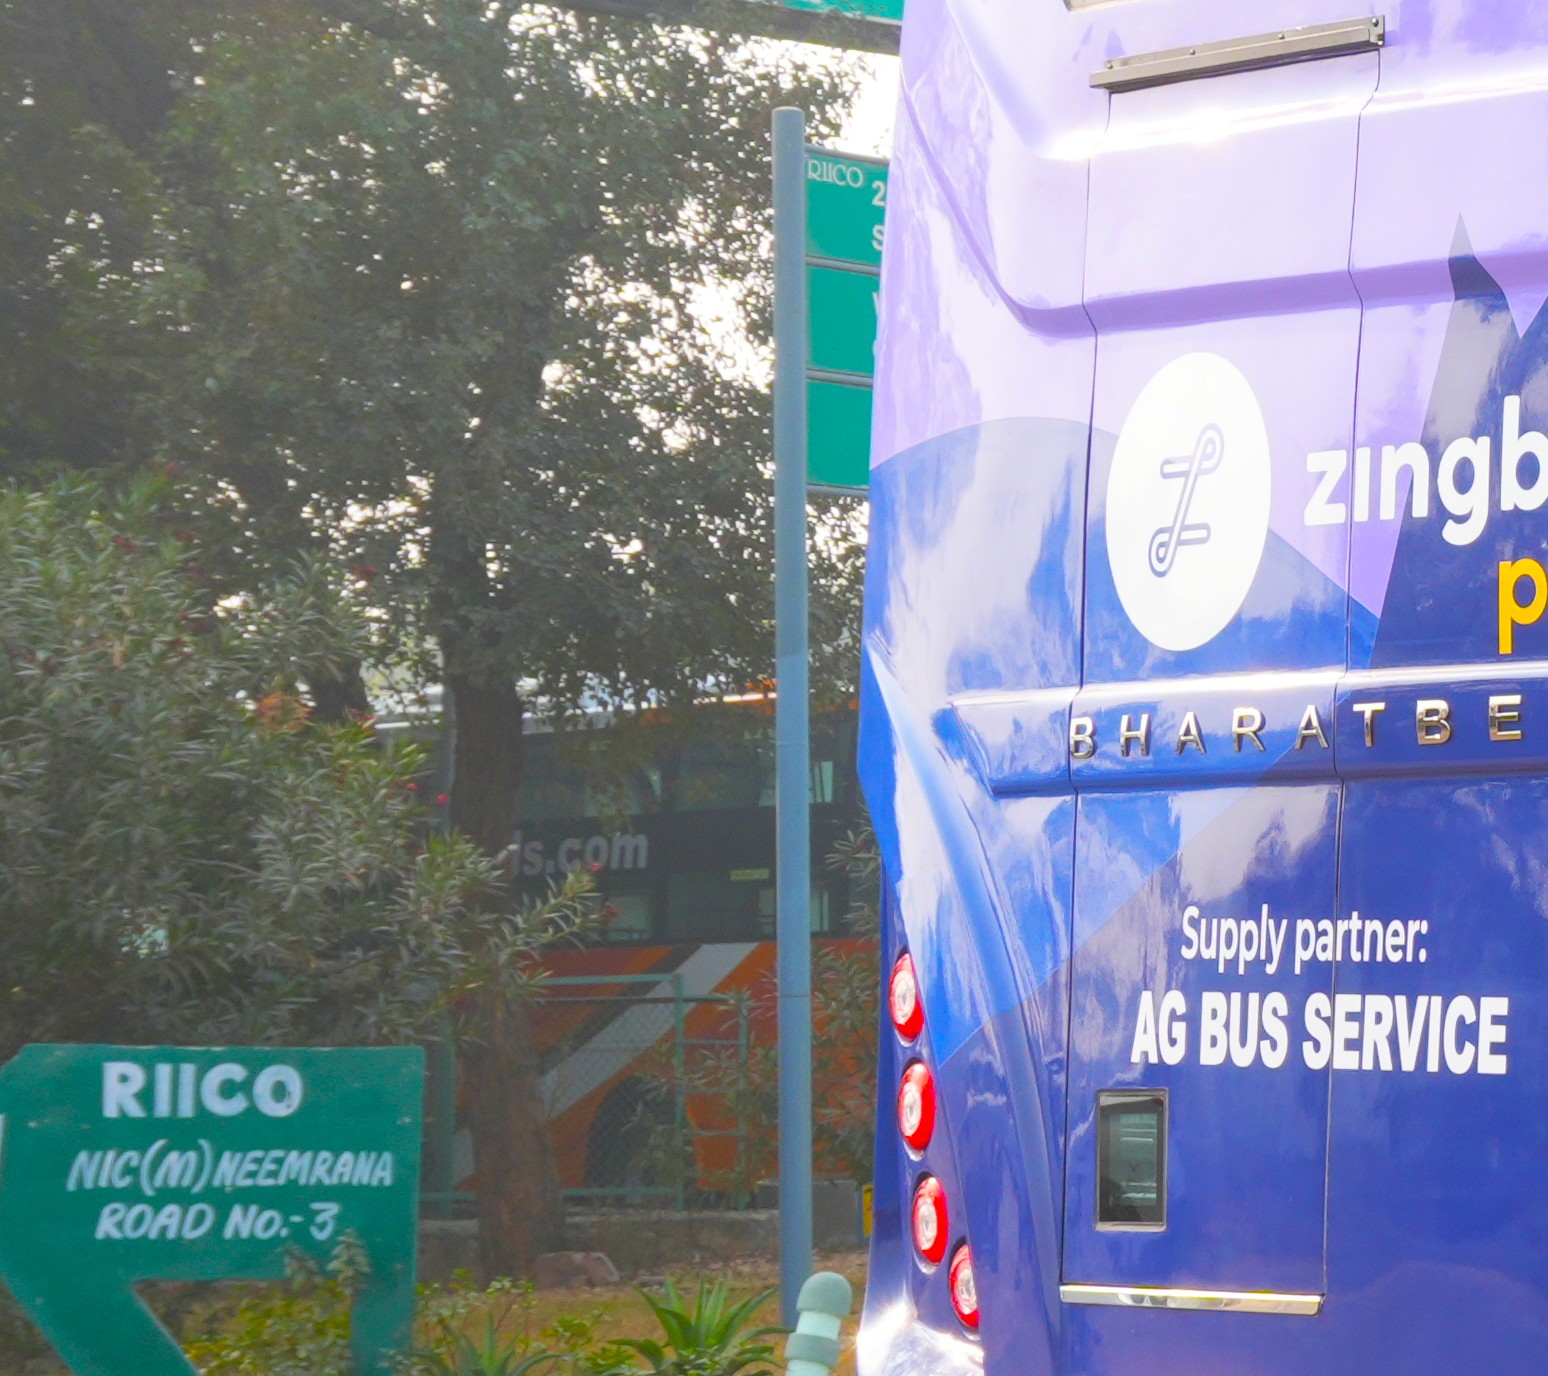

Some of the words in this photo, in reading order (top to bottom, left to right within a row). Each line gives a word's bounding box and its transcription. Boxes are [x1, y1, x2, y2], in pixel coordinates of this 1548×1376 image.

[807, 159, 865, 188] RIICO
[1180, 903, 1289, 975] Supply
[1294, 910, 1429, 974] partner:
[1130, 990, 1187, 1065] AG
[1200, 991, 1289, 1069] BUS
[1302, 992, 1509, 1075] SERVICE
[102, 1061, 304, 1118] RIICO
[95, 1202, 215, 1241] ROAD
